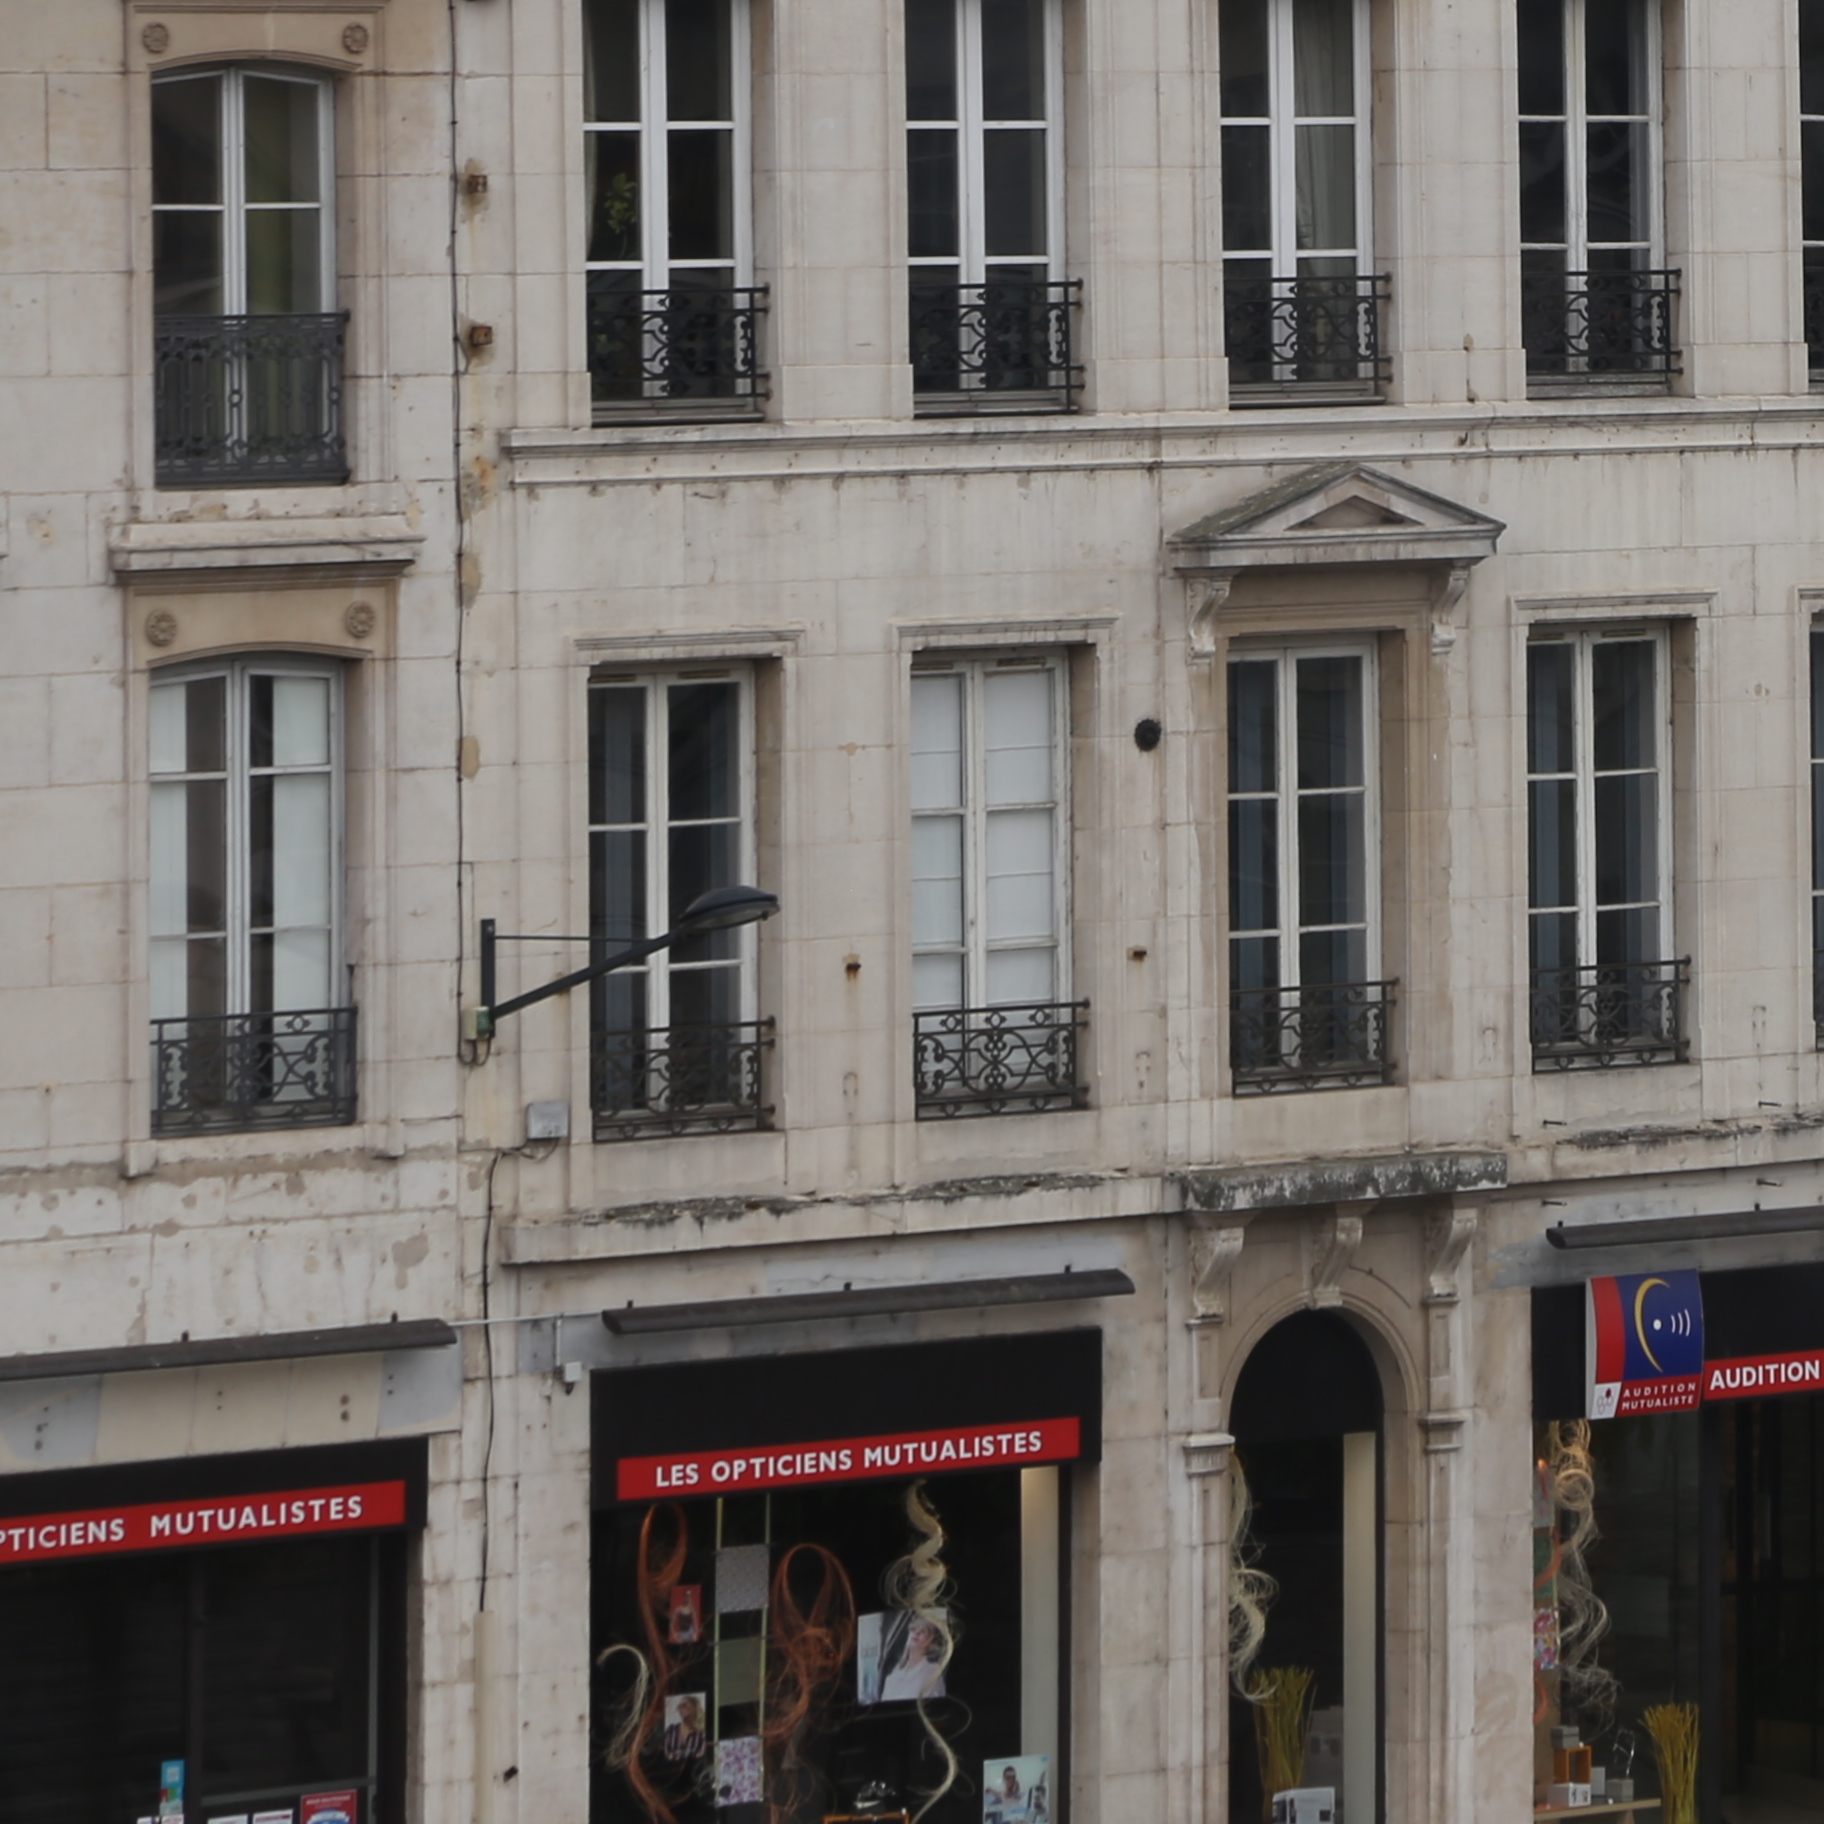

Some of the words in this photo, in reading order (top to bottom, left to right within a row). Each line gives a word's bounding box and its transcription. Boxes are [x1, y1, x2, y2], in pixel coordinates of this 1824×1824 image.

[1622, 1382, 1697, 1398] AUDITION
[1710, 1360, 1820, 1391] AUDITION
[1621, 1394, 1695, 1410] MUTUALISTE
[655, 1463, 699, 1488] LES
[711, 1449, 852, 1483] OPTICIENS
[863, 1431, 1042, 1468] MUTUALISTES
[150, 1495, 362, 1538] MUTUALISTES
